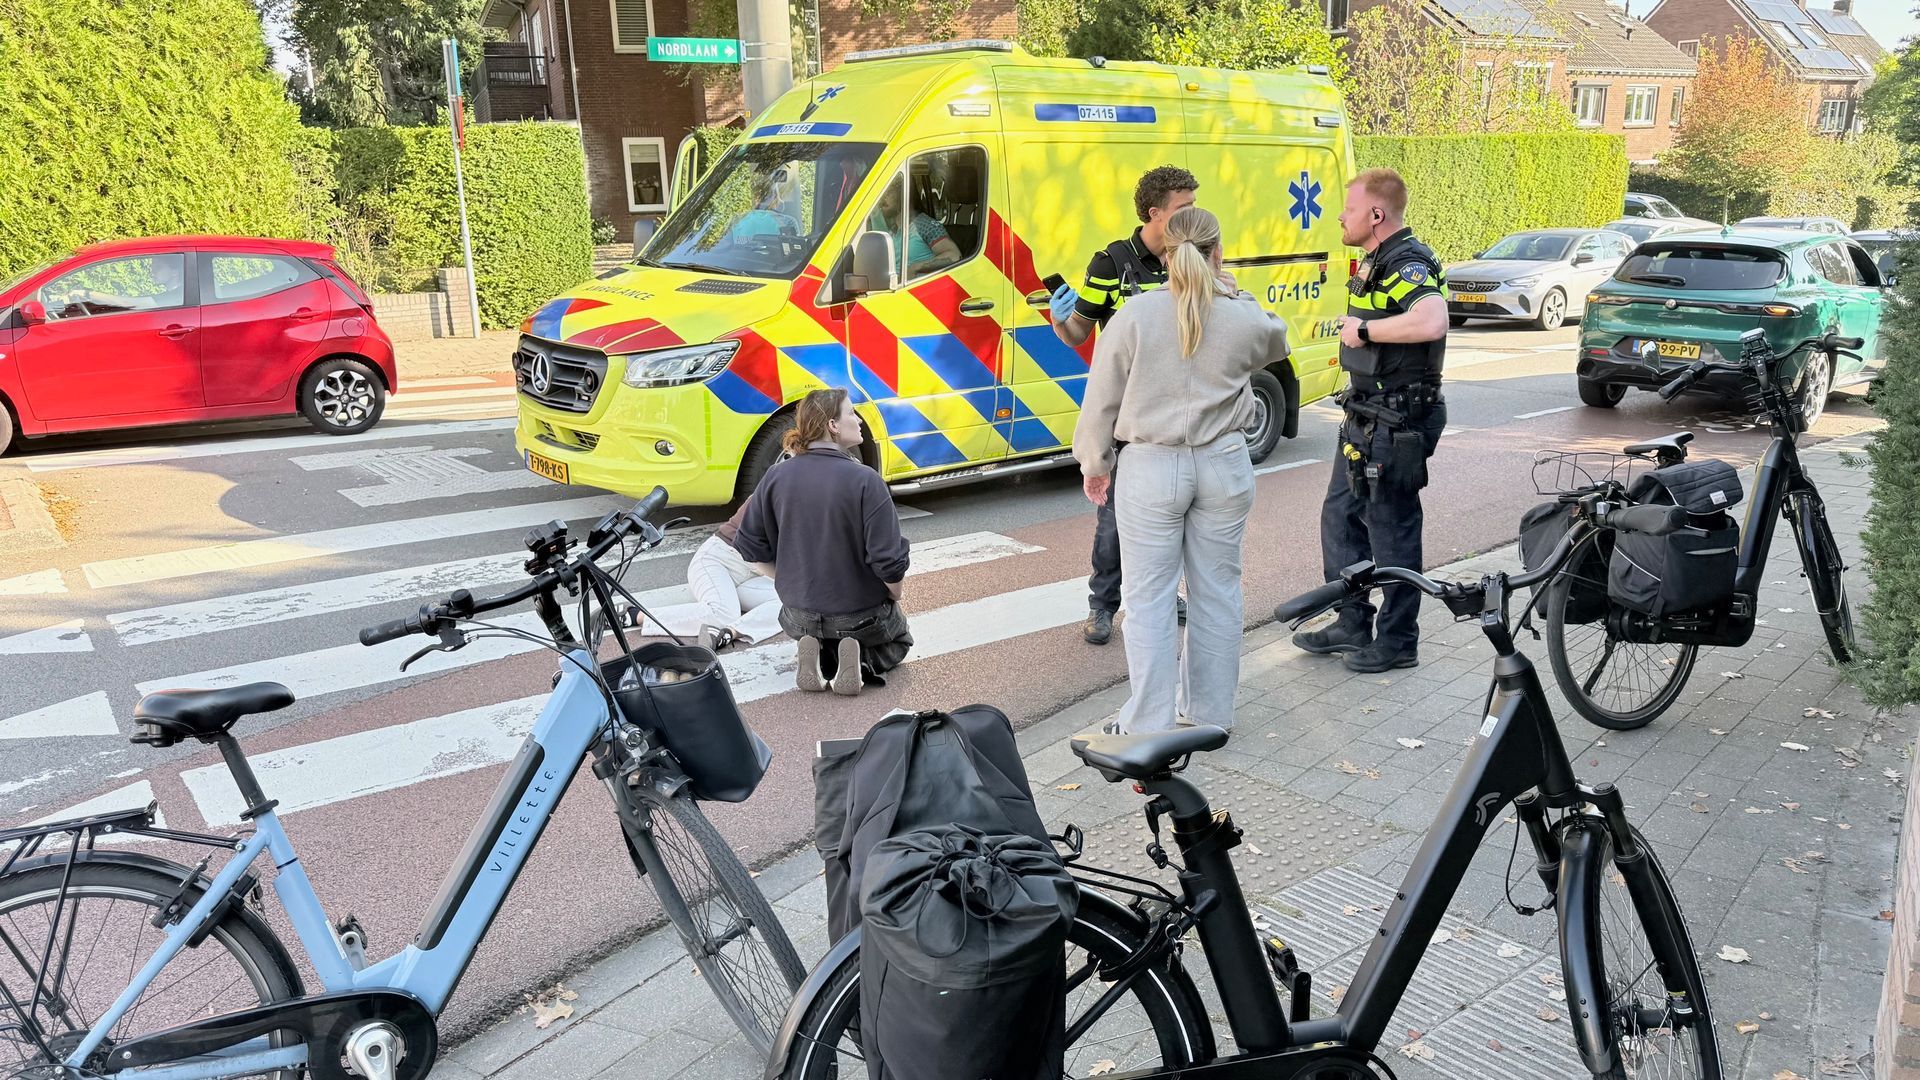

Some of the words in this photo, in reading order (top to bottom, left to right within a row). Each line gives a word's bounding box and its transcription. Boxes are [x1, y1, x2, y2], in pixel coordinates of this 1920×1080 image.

[657, 43, 718, 57] NORDLAAN
[1079, 107, 1114, 119] 07-115
[780, 124, 811, 133] 07-115
[583, 285, 655, 301] AMBULANCE
[1267, 281, 1320, 303] 07-115
[529, 454, 564, 480] T-798-KS
